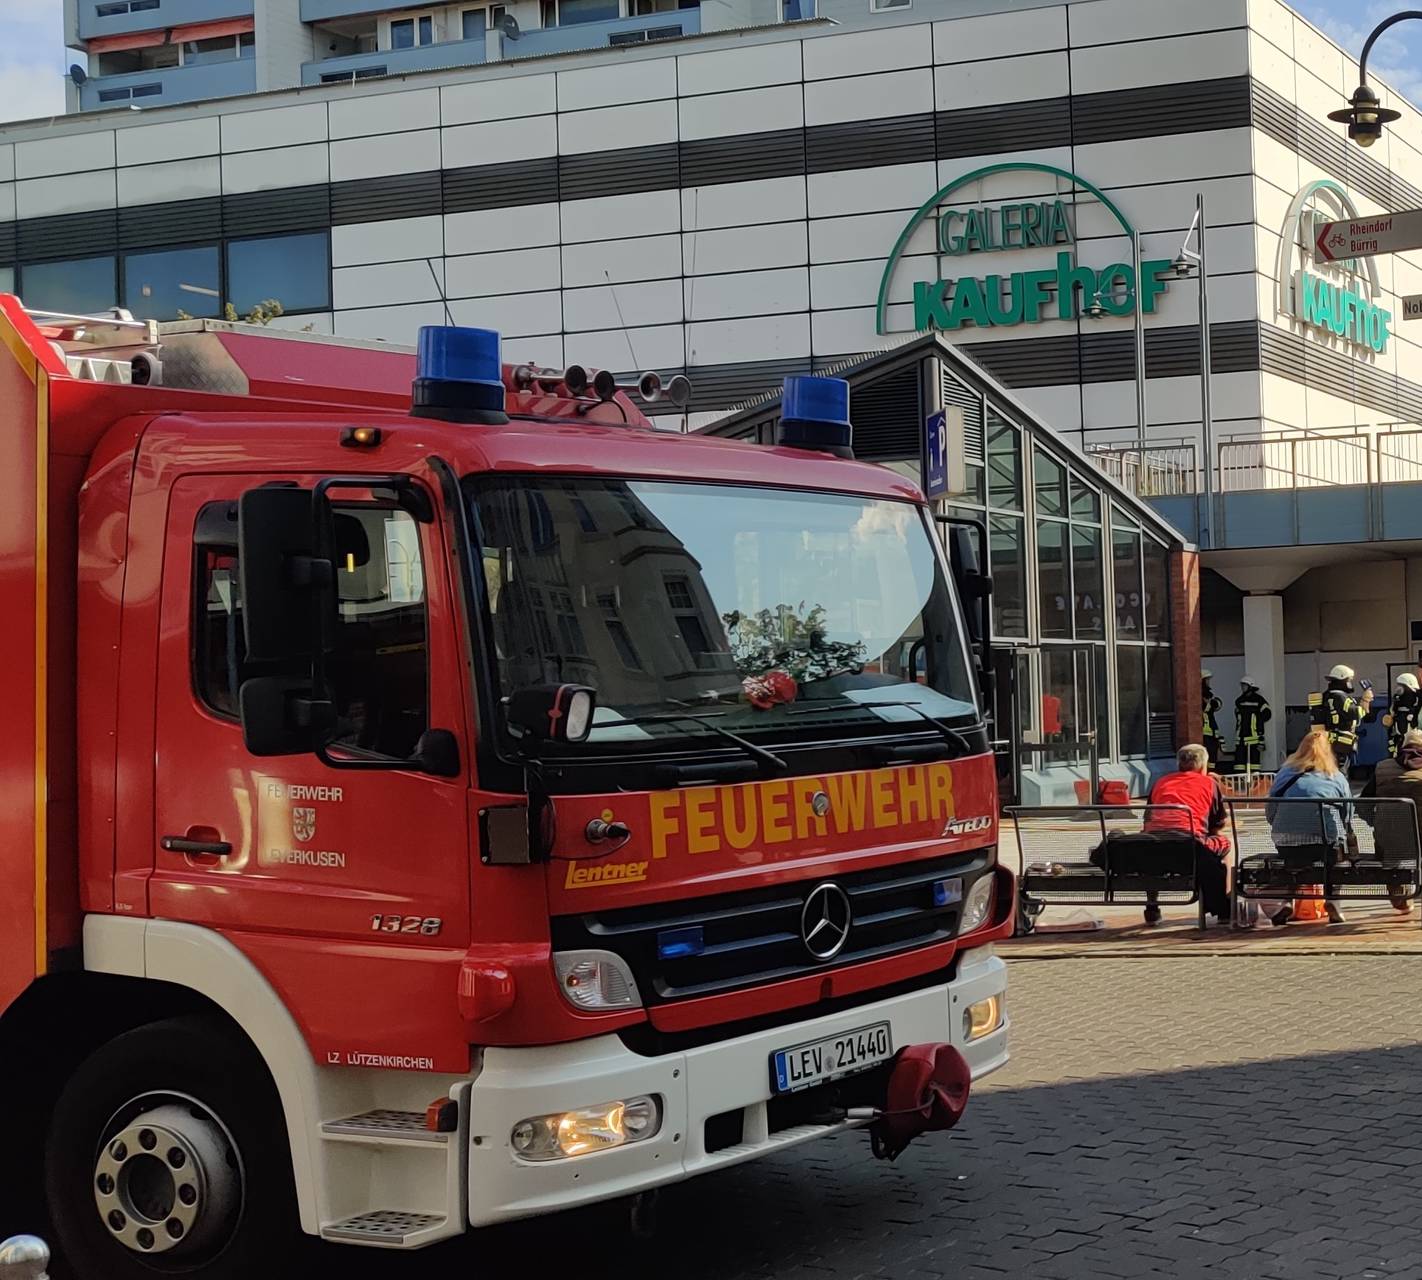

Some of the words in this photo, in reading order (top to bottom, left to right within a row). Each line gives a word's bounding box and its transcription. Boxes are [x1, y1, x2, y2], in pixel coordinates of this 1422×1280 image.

[940, 200, 1075, 256] GALERIA
[1350, 218, 1393, 237] Rheindorf
[1350, 239, 1379, 253] Bürrig
[648, 764, 956, 859] FEUERWEHR
[564, 860, 649, 890] Lentner
[370, 913, 442, 936] 1328
[327, 1051, 340, 1064] LZ
[346, 1050, 434, 1069] LÜTZENKIRCHEN
[789, 1046, 823, 1082] LEV
[836, 1029, 887, 1068] 21440
